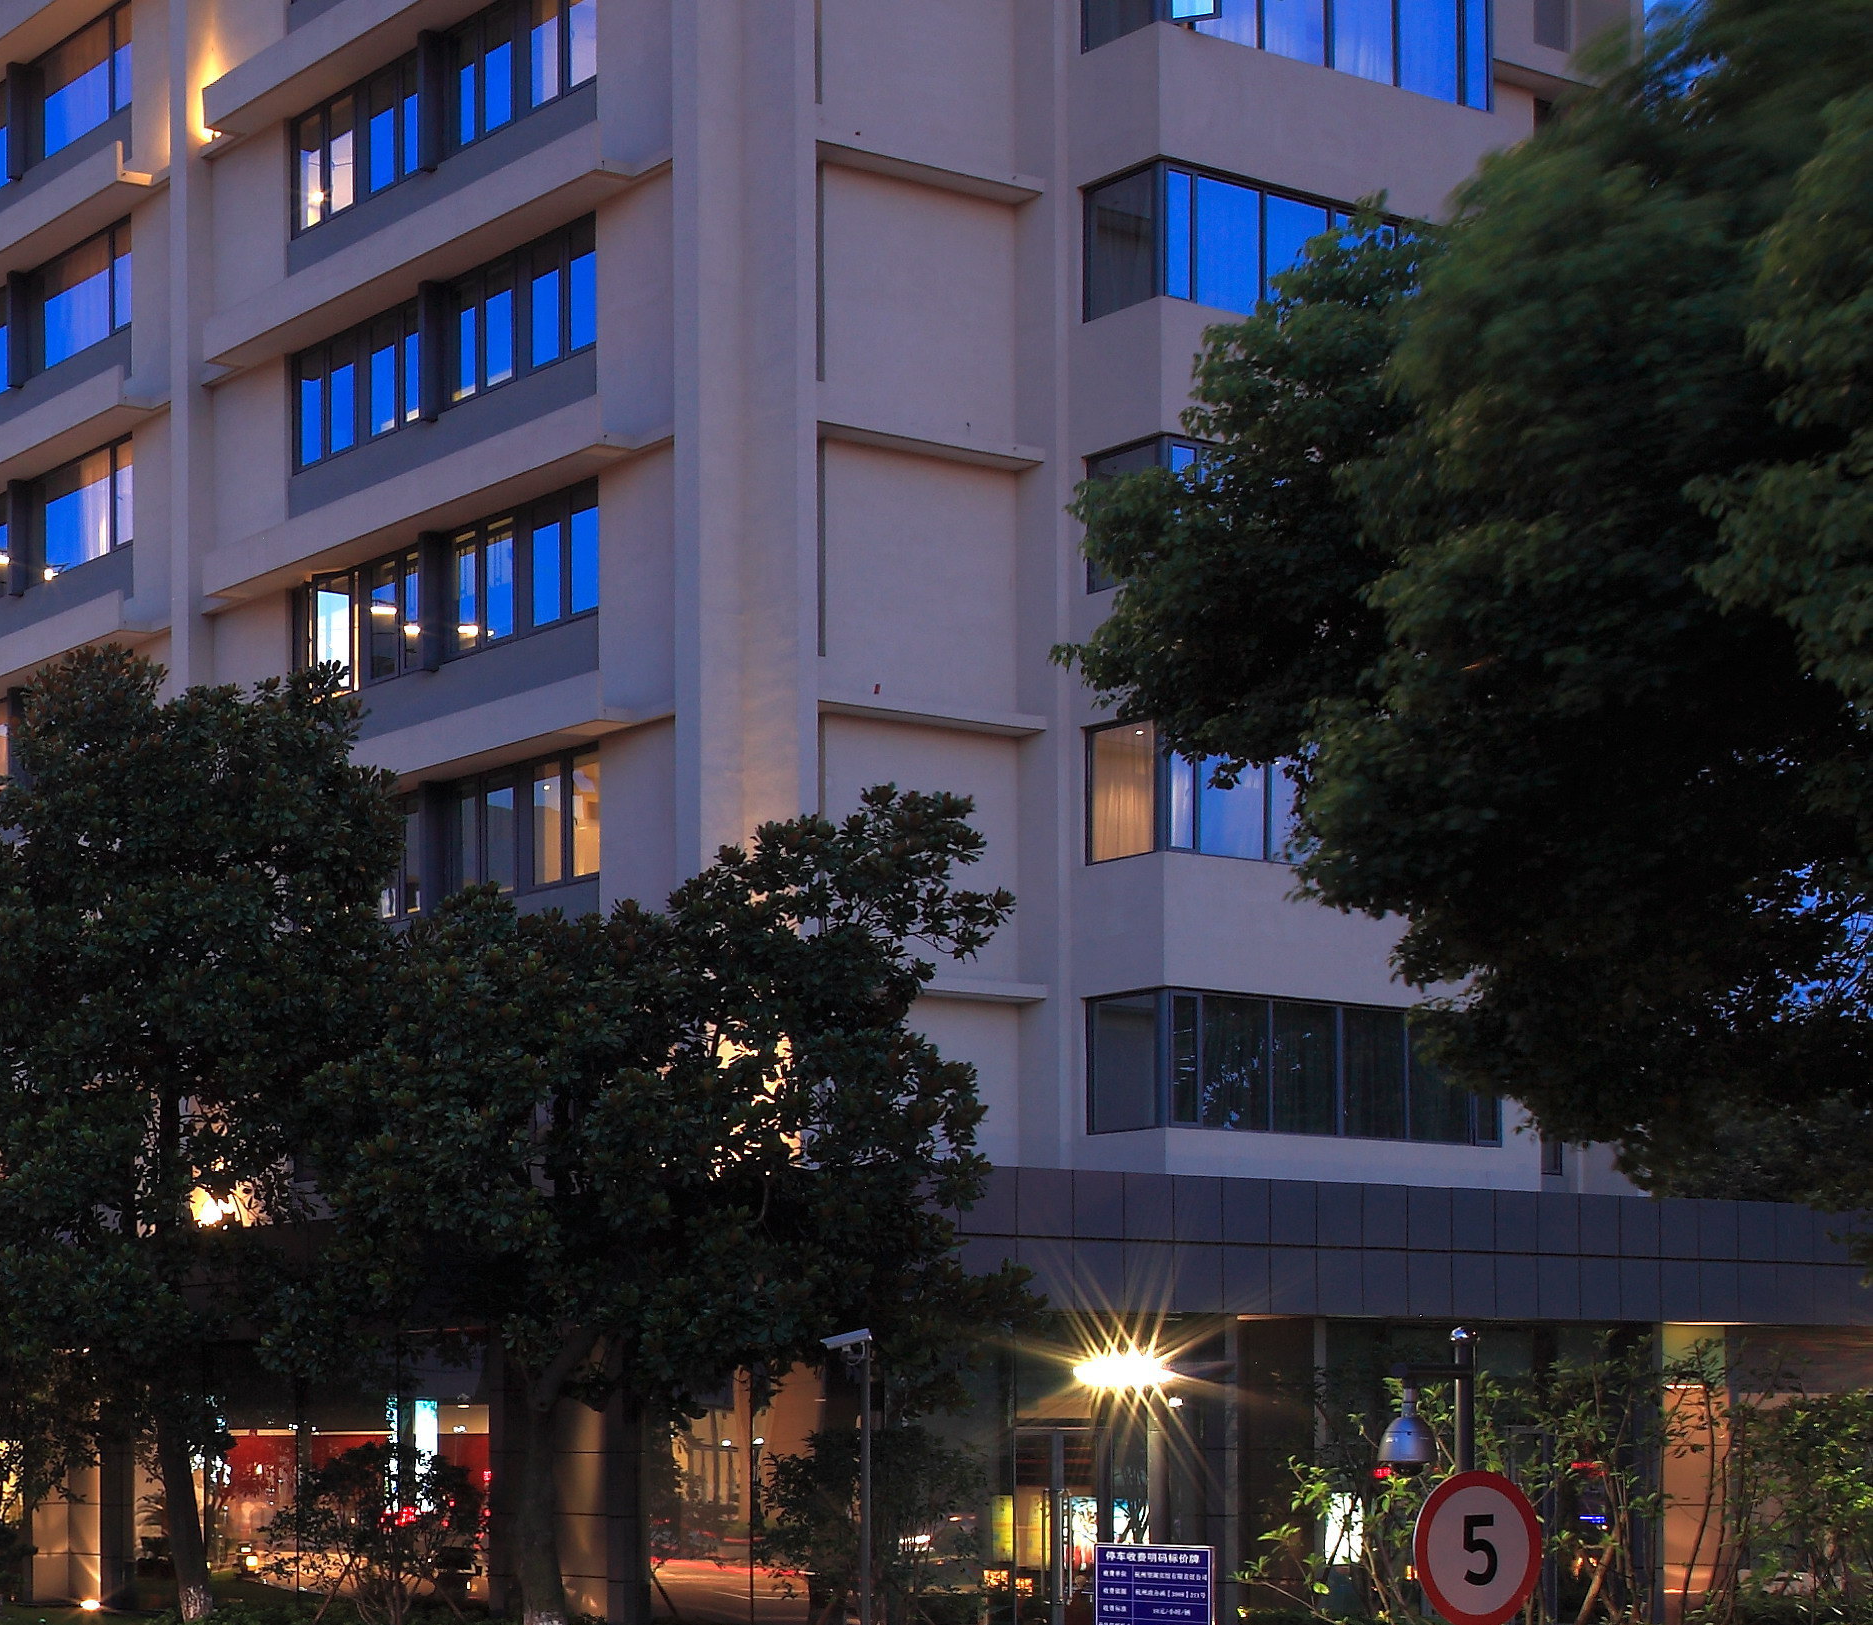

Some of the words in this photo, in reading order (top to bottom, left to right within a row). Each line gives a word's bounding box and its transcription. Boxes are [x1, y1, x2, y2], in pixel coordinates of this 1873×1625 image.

[1105, 1551, 1200, 1564] 停车收费明码标价牌
[1463, 1514, 1498, 1586] 5
